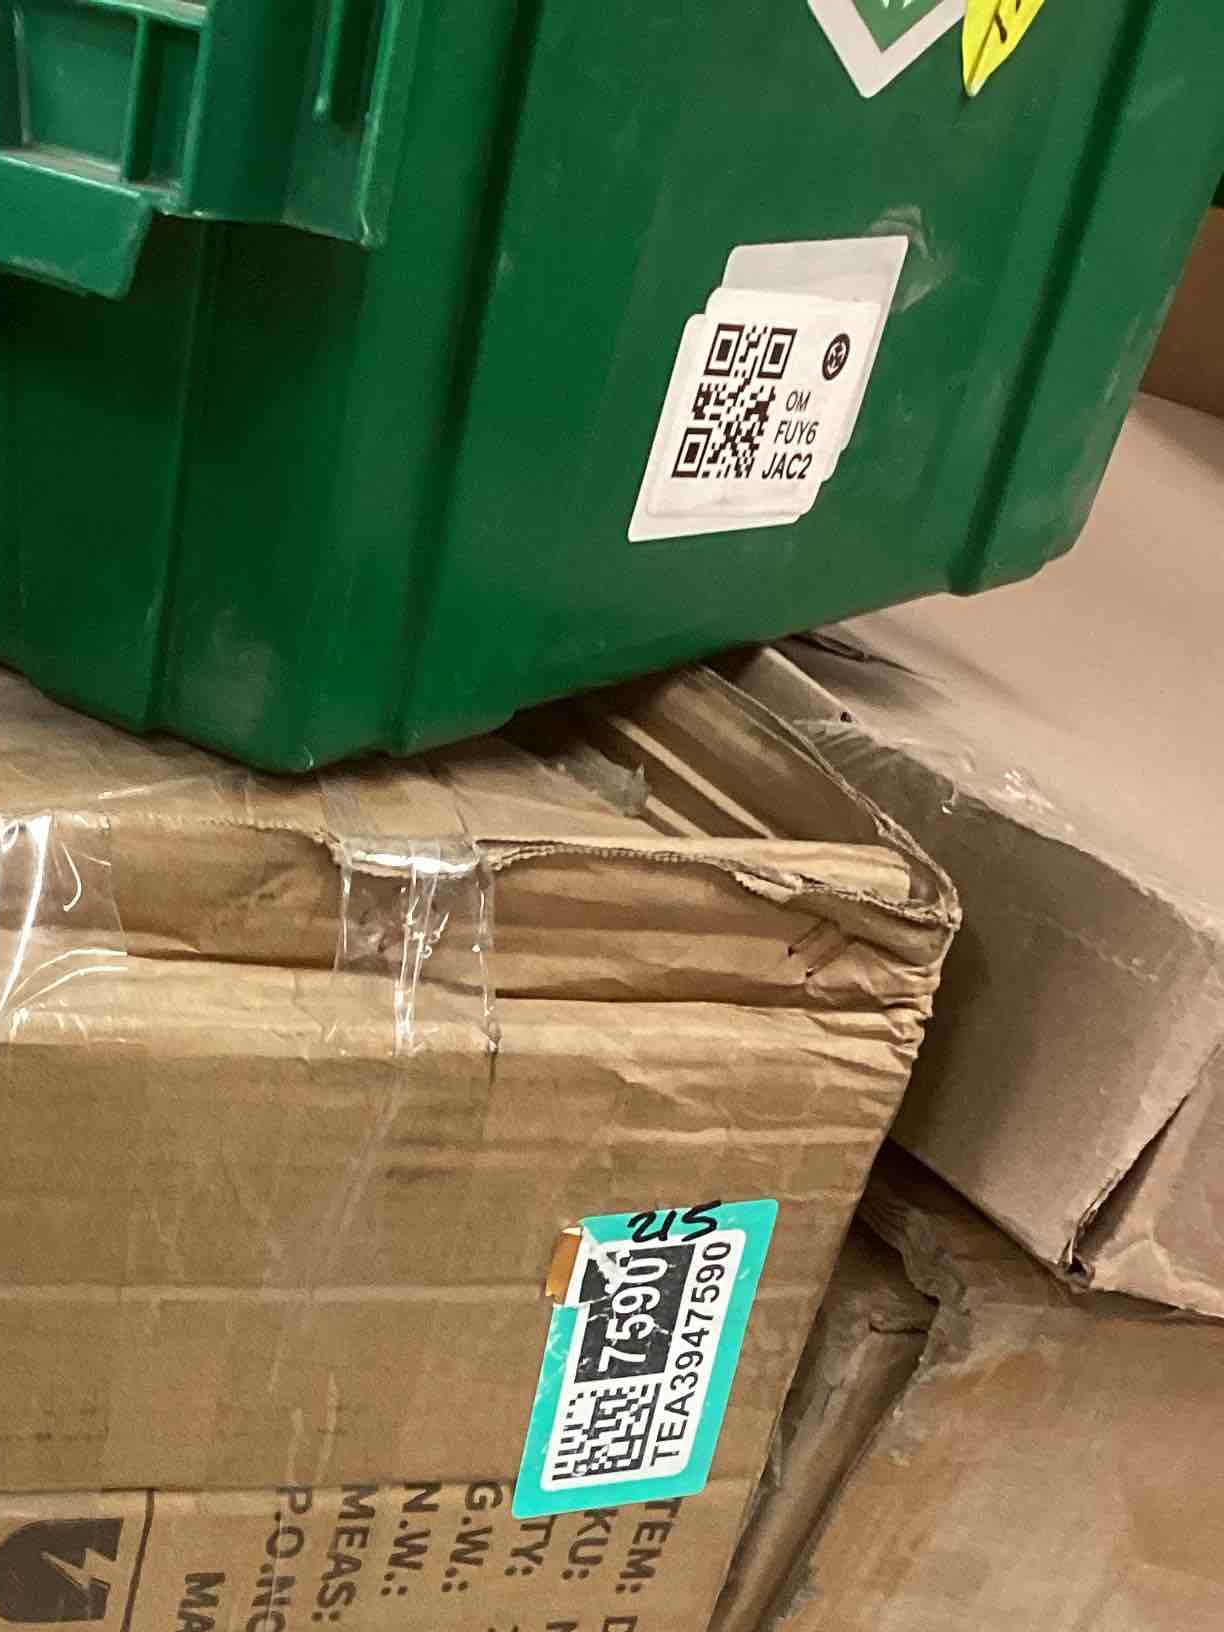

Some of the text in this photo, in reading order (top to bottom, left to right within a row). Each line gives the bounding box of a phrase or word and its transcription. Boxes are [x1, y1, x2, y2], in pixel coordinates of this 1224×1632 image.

[774, 420, 820, 445] FUY6
[785, 389, 812, 412] OM
[761, 451, 813, 480] JAC2
[597, 1256, 670, 1374] 7590
[650, 1240, 732, 1467] TEA3947590
[310, 1483, 378, 1624] MEAS:
[380, 1481, 442, 1597] N.W.:
[441, 1481, 504, 1593] G.W.:
[503, 1514, 556, 1578] TY:
[561, 1508, 618, 1582] KU:
[615, 1496, 683, 1595] TEM:
